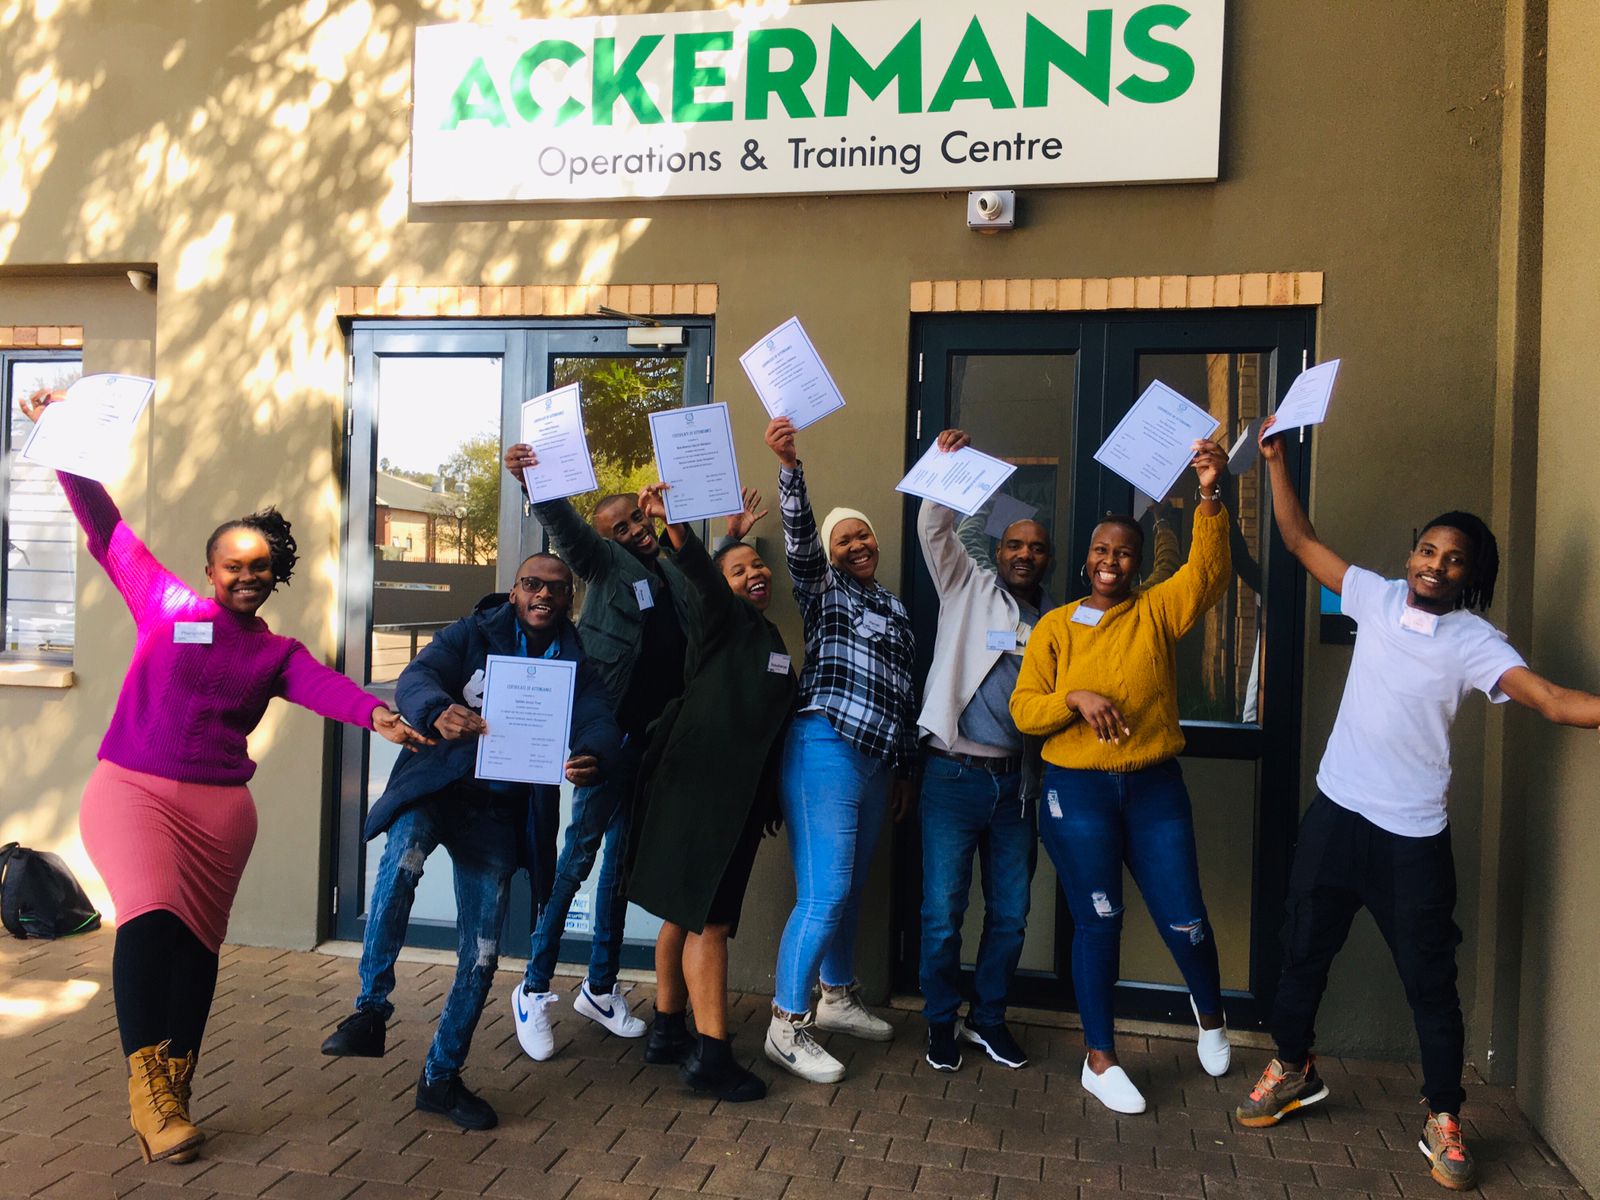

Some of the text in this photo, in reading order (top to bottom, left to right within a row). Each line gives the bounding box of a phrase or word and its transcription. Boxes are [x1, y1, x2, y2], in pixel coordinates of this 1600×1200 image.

[438, 3, 1195, 130] ACKERMANS
[538, 130, 1063, 184] Operations & Training Centre
